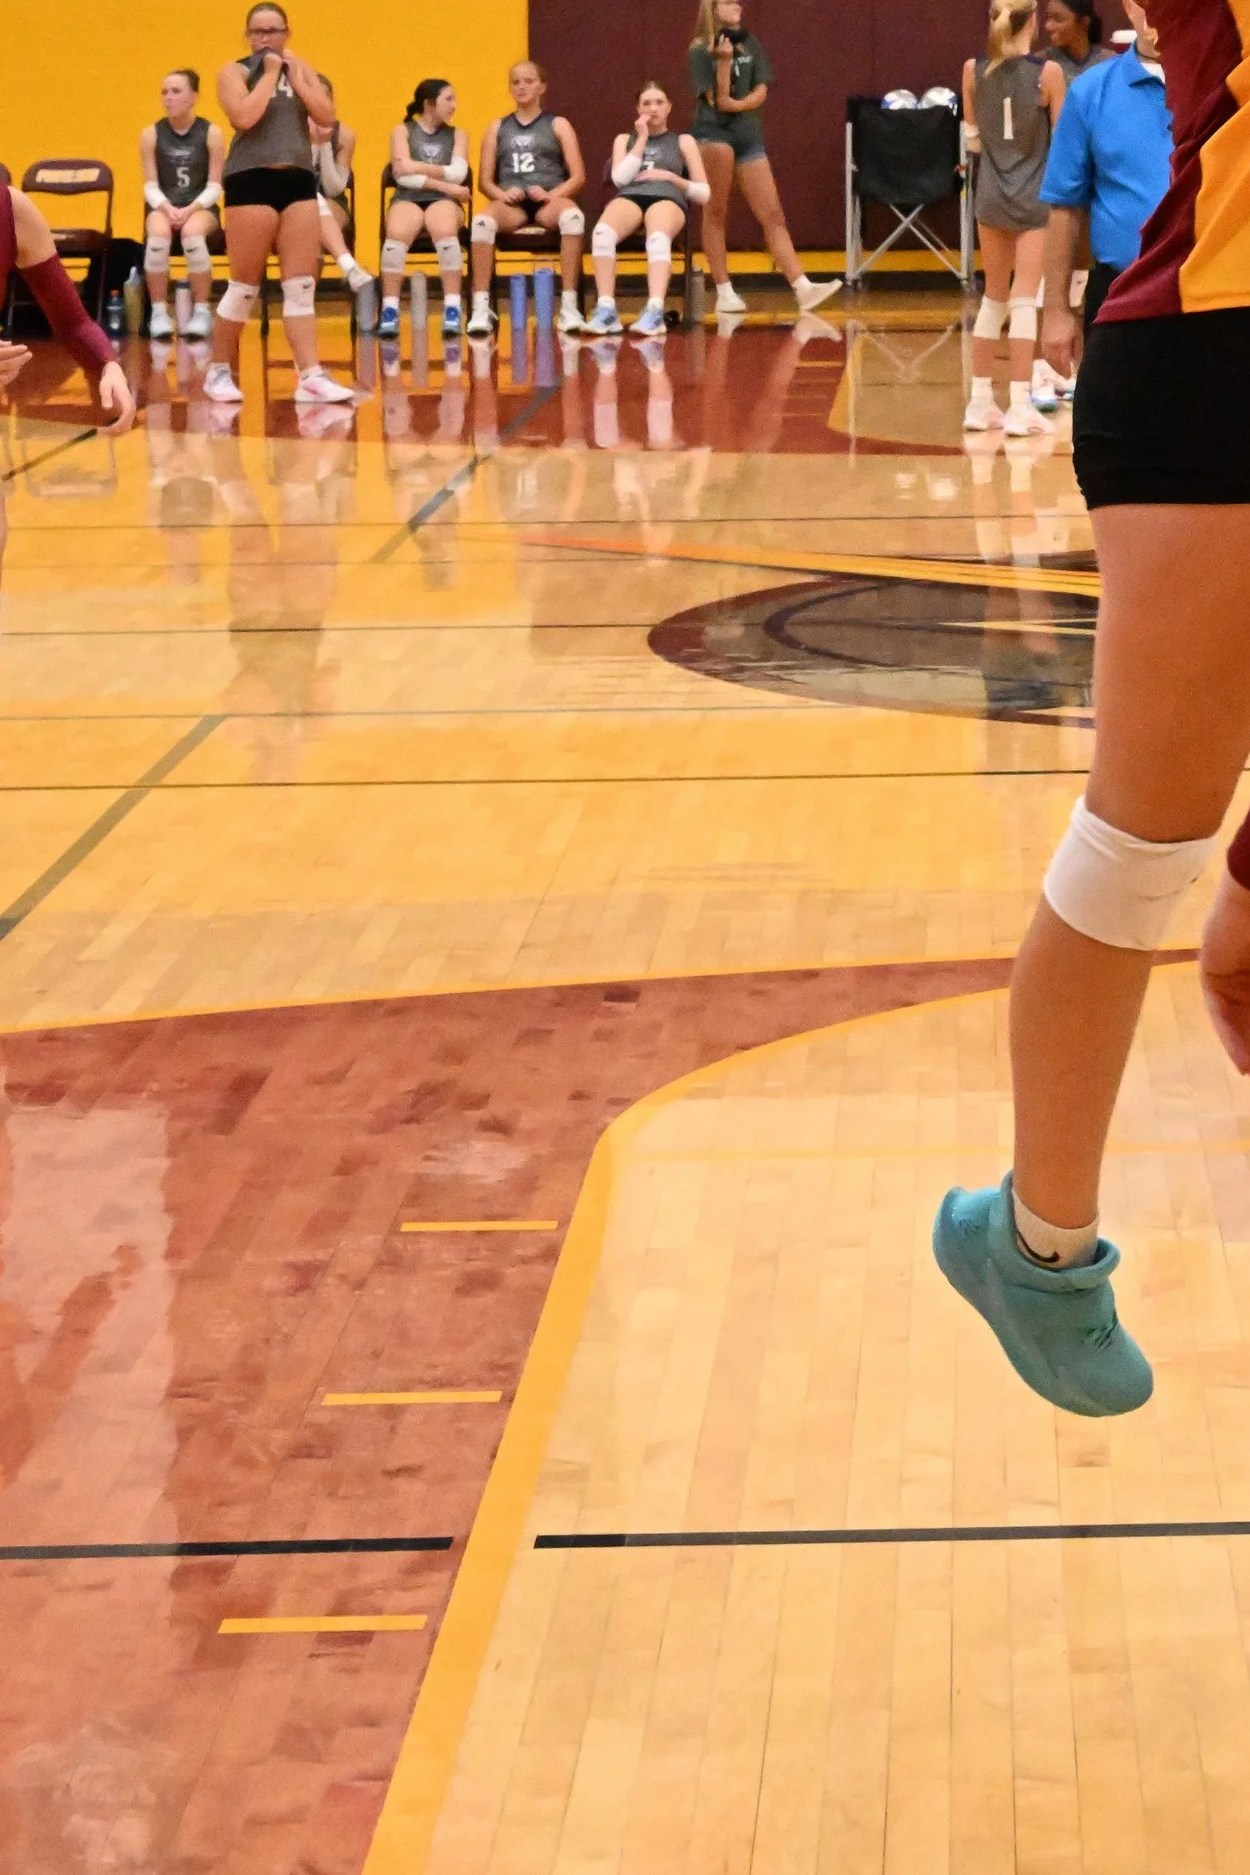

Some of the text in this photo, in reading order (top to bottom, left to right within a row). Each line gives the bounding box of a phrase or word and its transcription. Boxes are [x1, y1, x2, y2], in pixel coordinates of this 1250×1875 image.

[1002, 97, 1015, 141] 1
[511, 152, 535, 173] 12
[176, 166, 191, 188] 5
